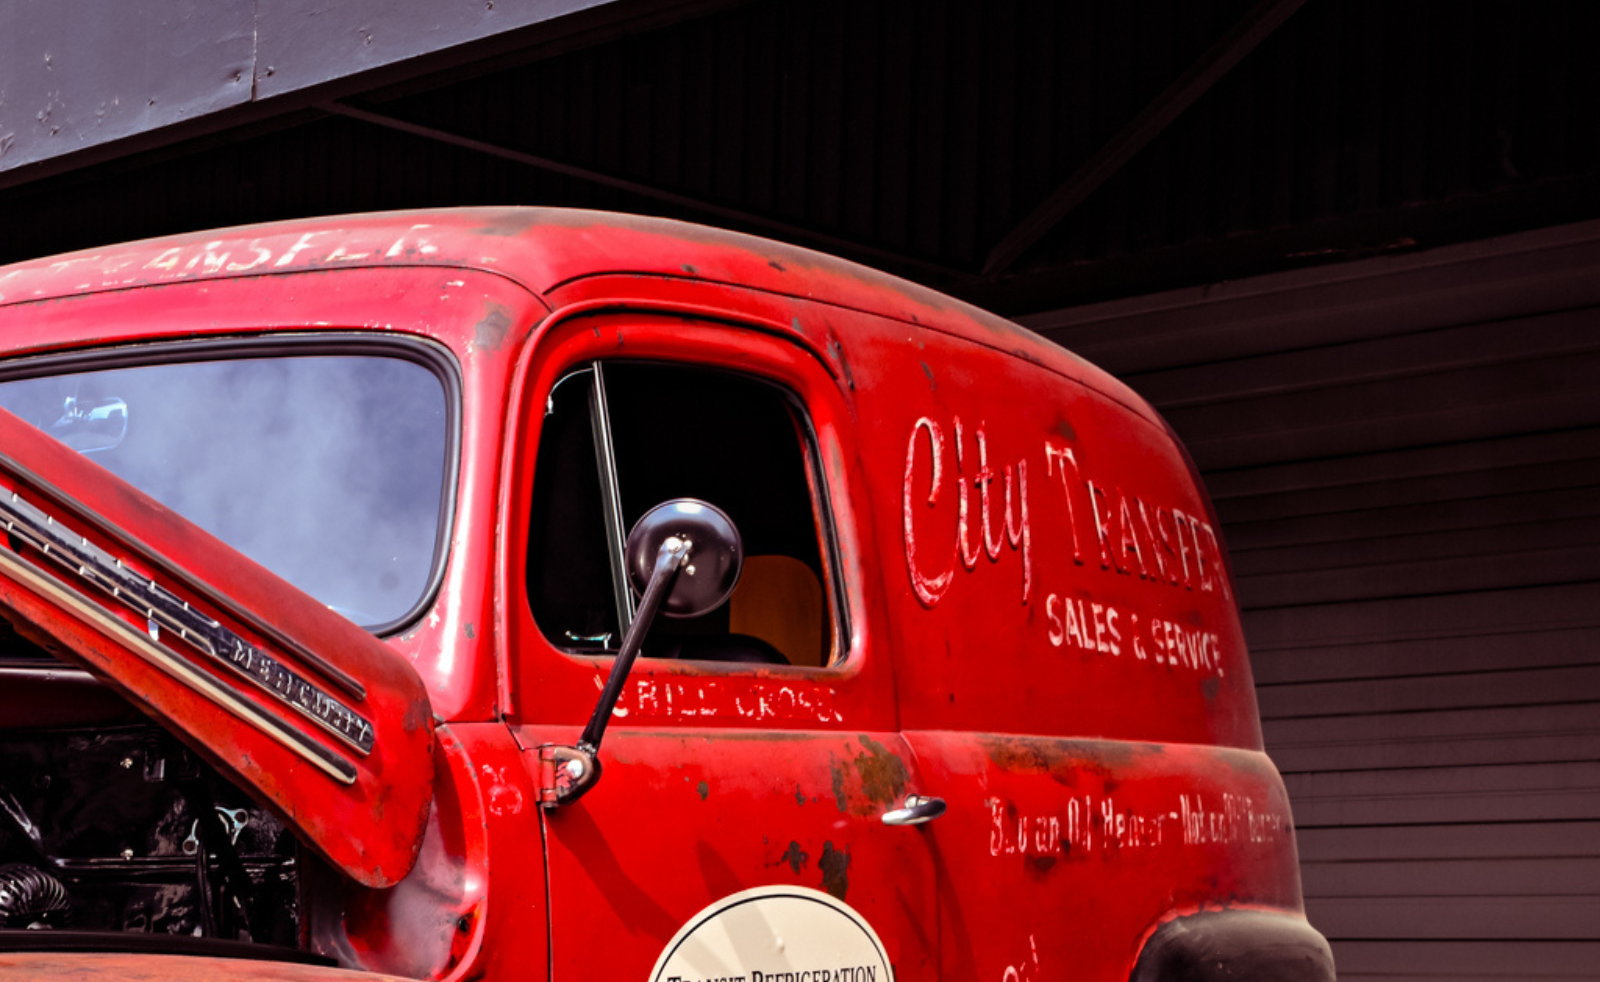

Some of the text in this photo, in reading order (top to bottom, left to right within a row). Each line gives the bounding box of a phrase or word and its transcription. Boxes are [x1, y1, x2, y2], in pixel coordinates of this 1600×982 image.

[903, 415, 1032, 605] City
[1046, 593, 1122, 656] SALES
[1152, 618, 1225, 678] SERVICE
